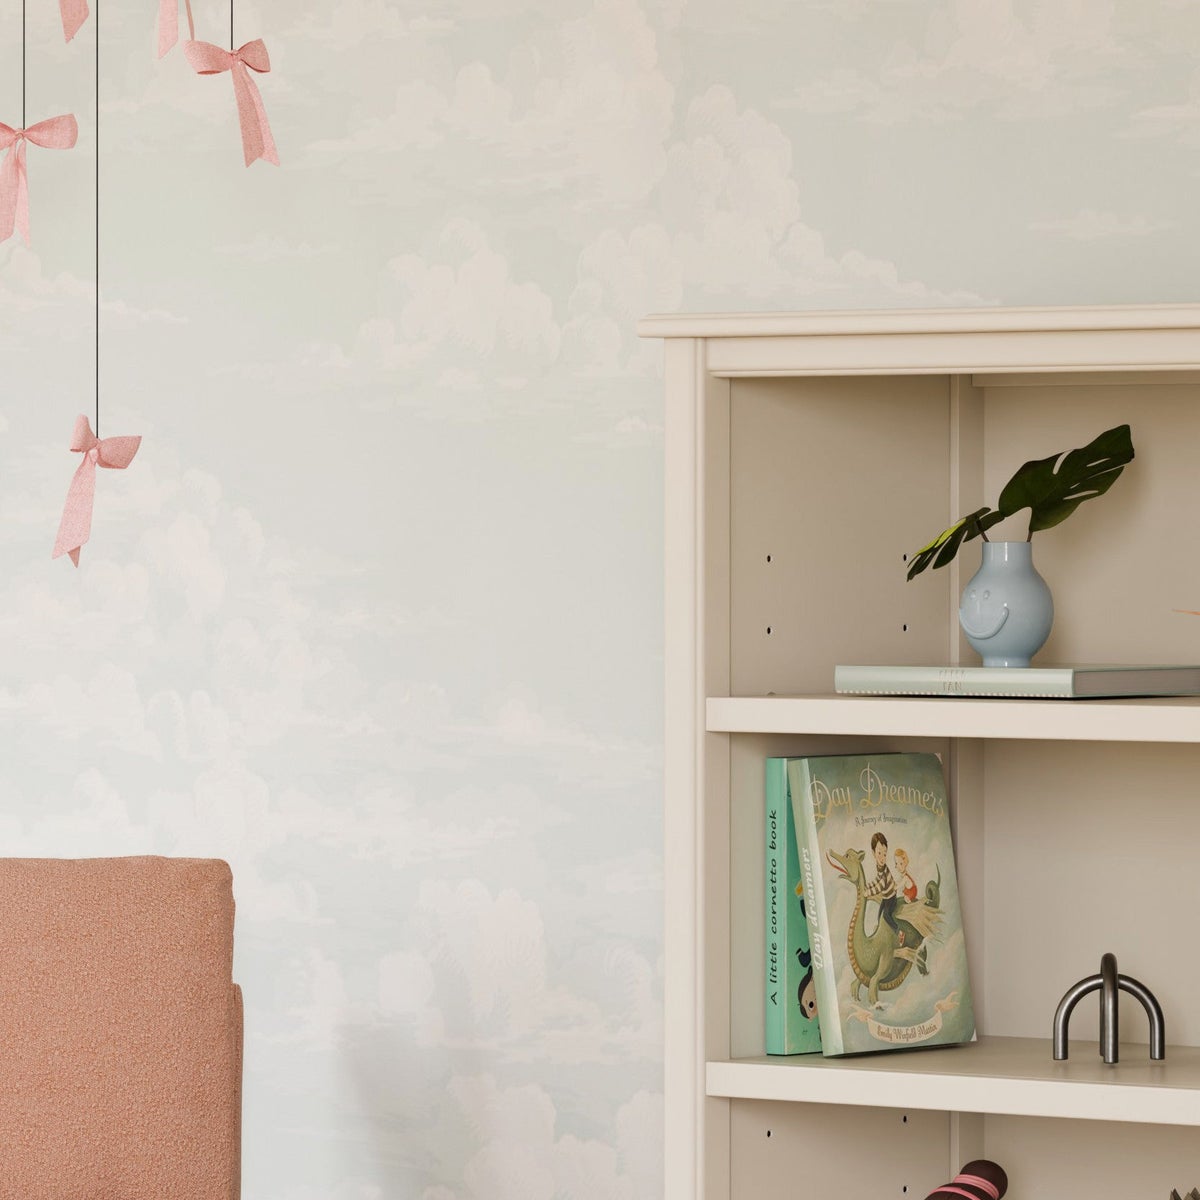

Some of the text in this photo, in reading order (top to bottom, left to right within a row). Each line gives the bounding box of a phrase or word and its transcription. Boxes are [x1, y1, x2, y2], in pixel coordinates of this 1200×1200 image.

[808, 762, 944, 824] Day Dreamers
[769, 810, 778, 1006] A little cornetto book
[812, 932, 824, 970] Day
